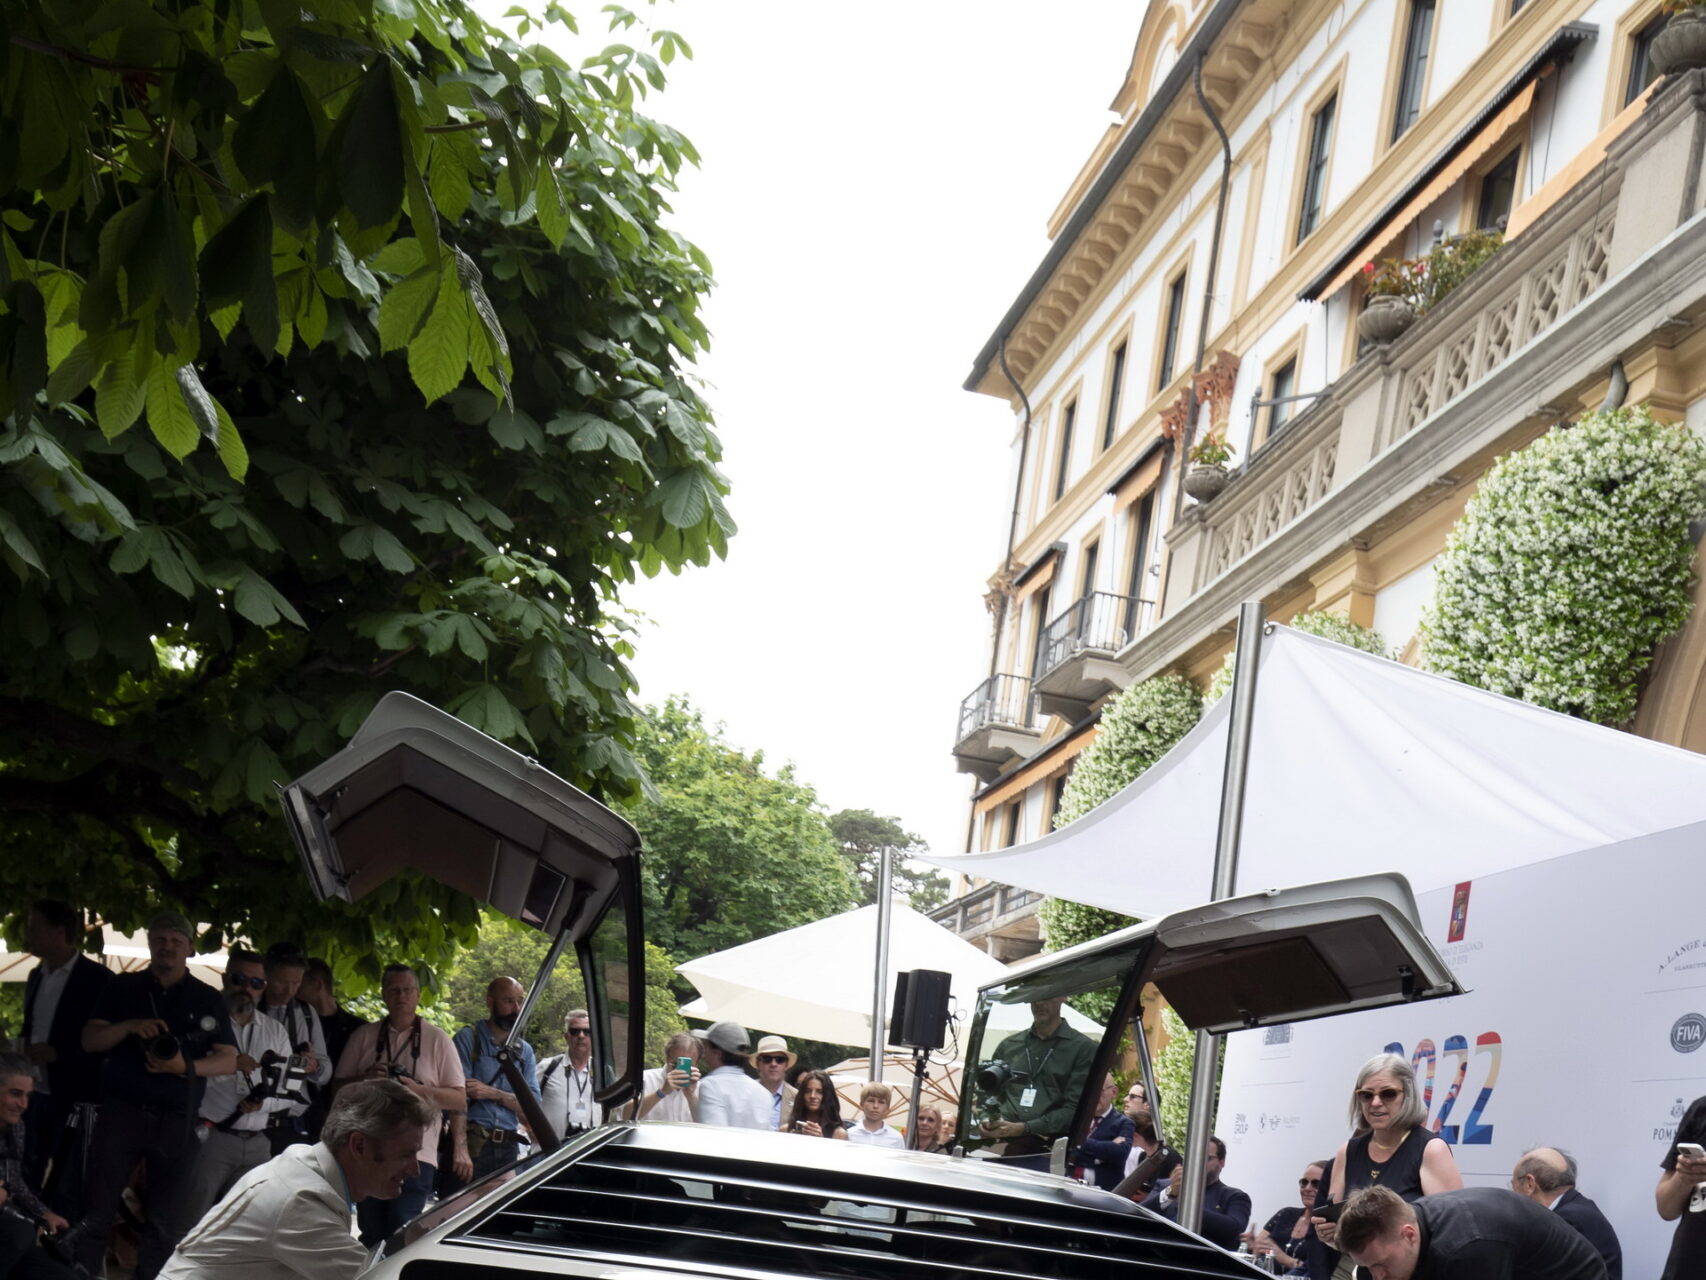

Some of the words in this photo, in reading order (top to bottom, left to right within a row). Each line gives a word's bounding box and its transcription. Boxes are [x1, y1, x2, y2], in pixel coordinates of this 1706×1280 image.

[1667, 939, 1701, 964] LANGE
[1676, 1024, 1701, 1041] FIVA
[1383, 1031, 1502, 1145] 022
